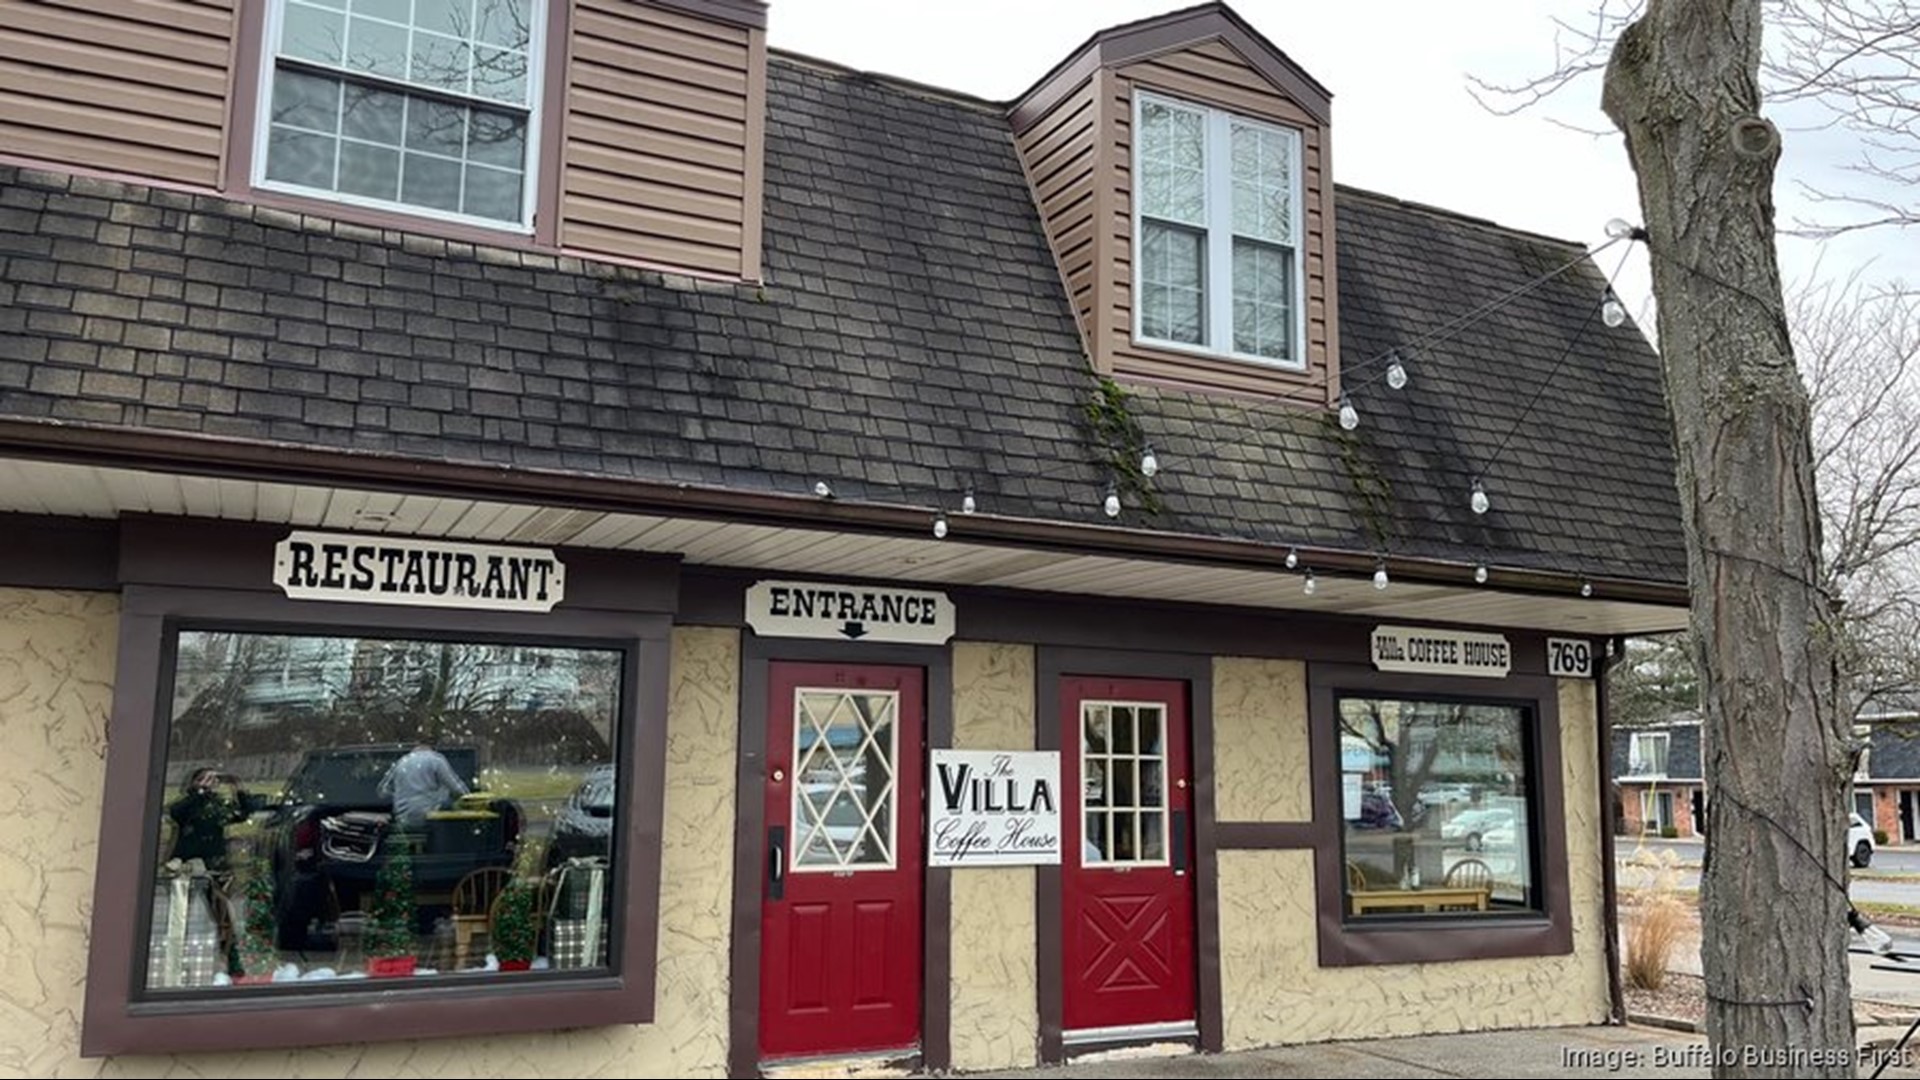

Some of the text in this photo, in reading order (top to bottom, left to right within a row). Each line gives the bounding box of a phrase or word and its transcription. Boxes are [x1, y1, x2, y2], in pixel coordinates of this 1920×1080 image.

[288, 541, 553, 601] RESTAURANT
[770, 587, 936, 625] ENTRANCE
[1408, 637, 1458, 664] COFFEE
[1463, 641, 1507, 667] HOUSE
[1551, 642, 1590, 673] 769
[984, 755, 1014, 777] The
[936, 763, 1056, 815] VILLA
[934, 817, 1057, 861] Coffee House
